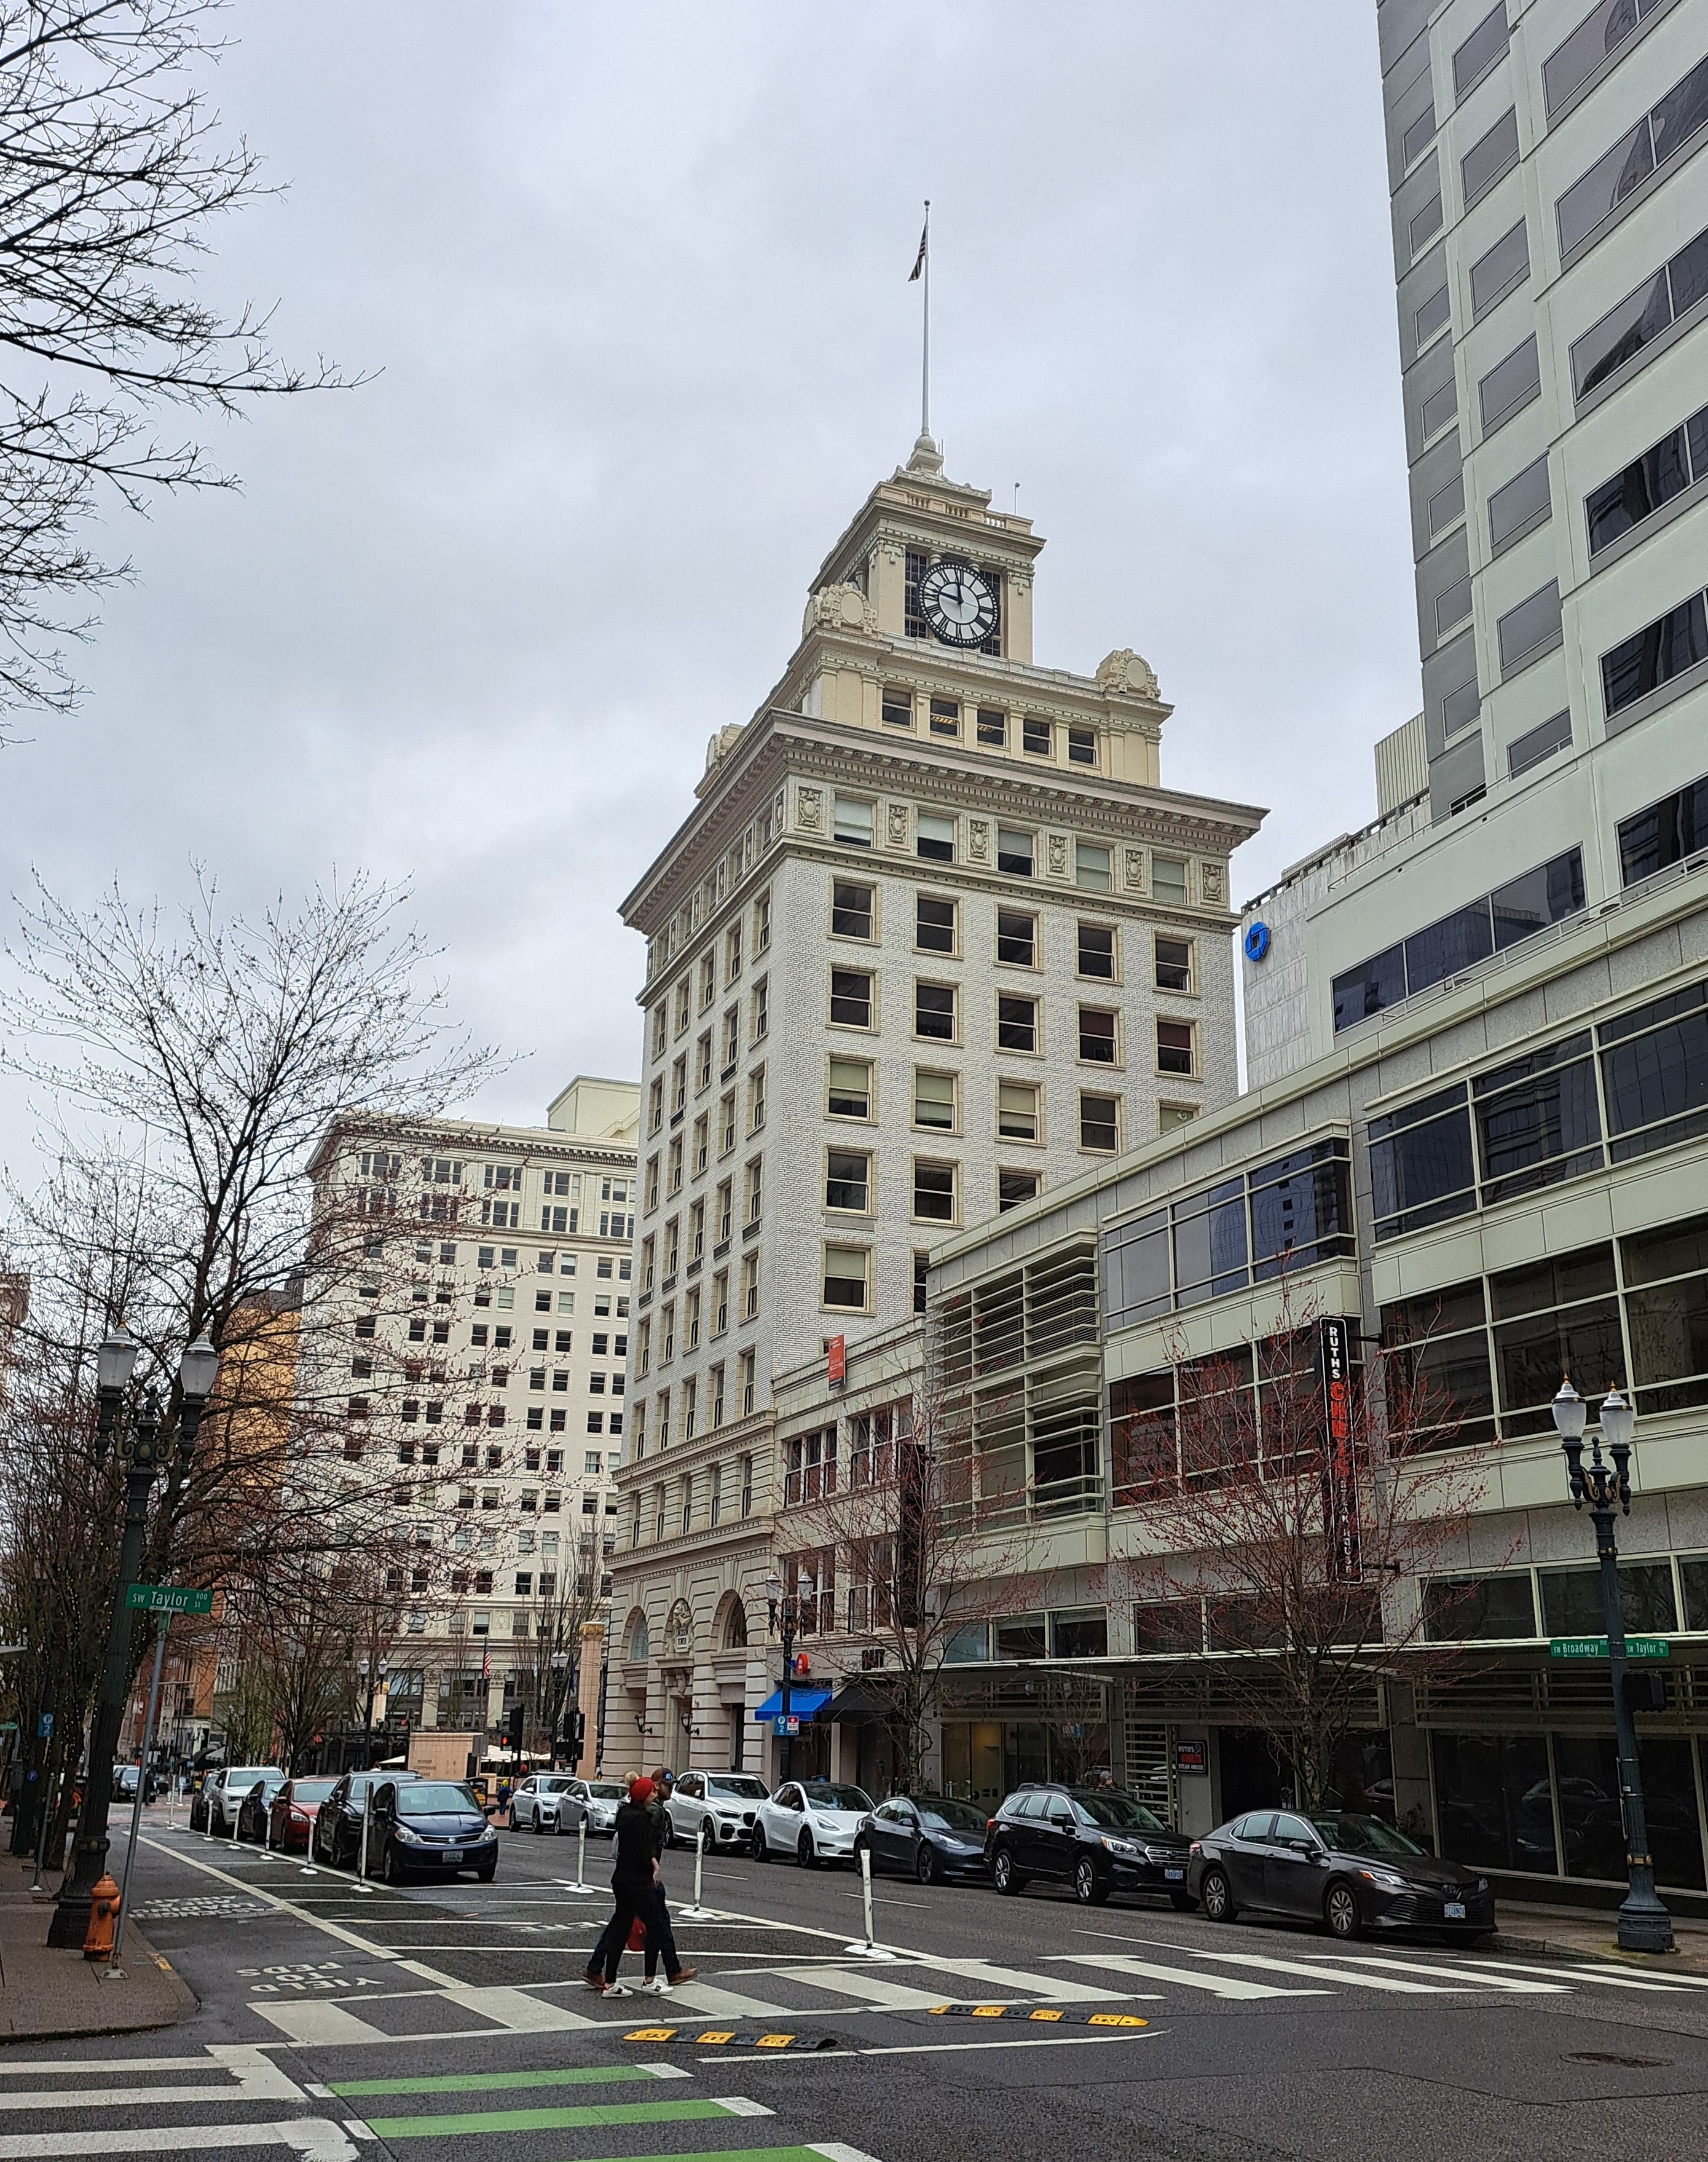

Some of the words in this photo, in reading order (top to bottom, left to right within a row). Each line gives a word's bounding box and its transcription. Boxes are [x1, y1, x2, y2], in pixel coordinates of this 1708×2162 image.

[1329, 1327, 1340, 1379] RUTHS
[132, 1593, 146, 1603] SW
[151, 1591, 189, 1608] Taylor
[195, 1592, 208, 1601] 900
[1562, 1643, 1599, 1655] Broadway
[1635, 1642, 1656, 1655] Taylor
[235, 1962, 344, 1977] PEDS
[276, 1972, 334, 1982] TO
[250, 1977, 385, 1992] YIELD
